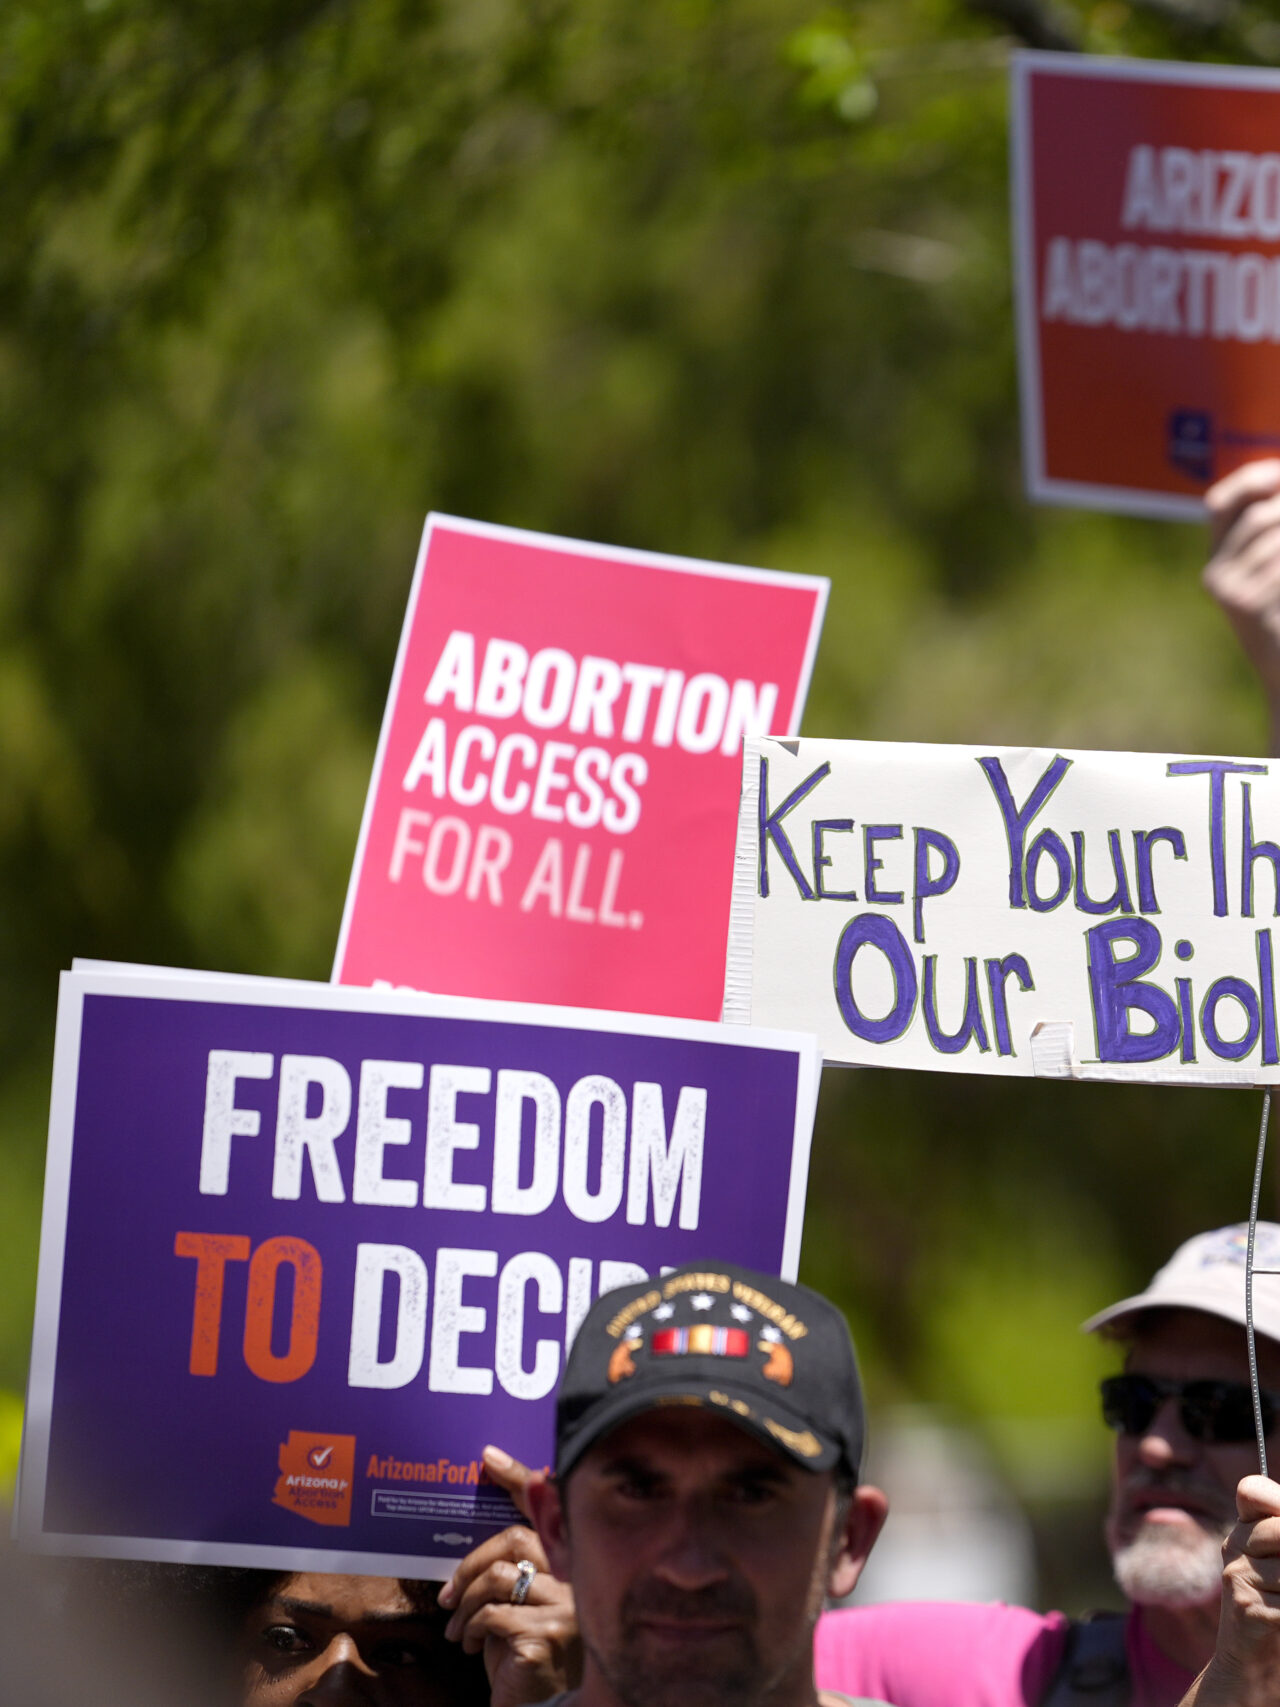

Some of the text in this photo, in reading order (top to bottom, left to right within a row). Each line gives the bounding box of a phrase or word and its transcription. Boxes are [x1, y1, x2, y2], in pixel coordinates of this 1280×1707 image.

[424, 630, 779, 757] ABORTION
[402, 717, 648, 834] ACCESS
[975, 754, 1187, 914] Your
[388, 807, 644, 930] FOR ALL.
[833, 913, 1036, 1058] Our
[200, 1048, 707, 1231] FREEDOM
[174, 1231, 678, 1400] TO DECI
[286, 1474, 338, 1491] Arizona
[288, 1487, 345, 1500] Abortion
[294, 1498, 338, 1510] Access
[366, 1454, 495, 1488] ArizonaForA
